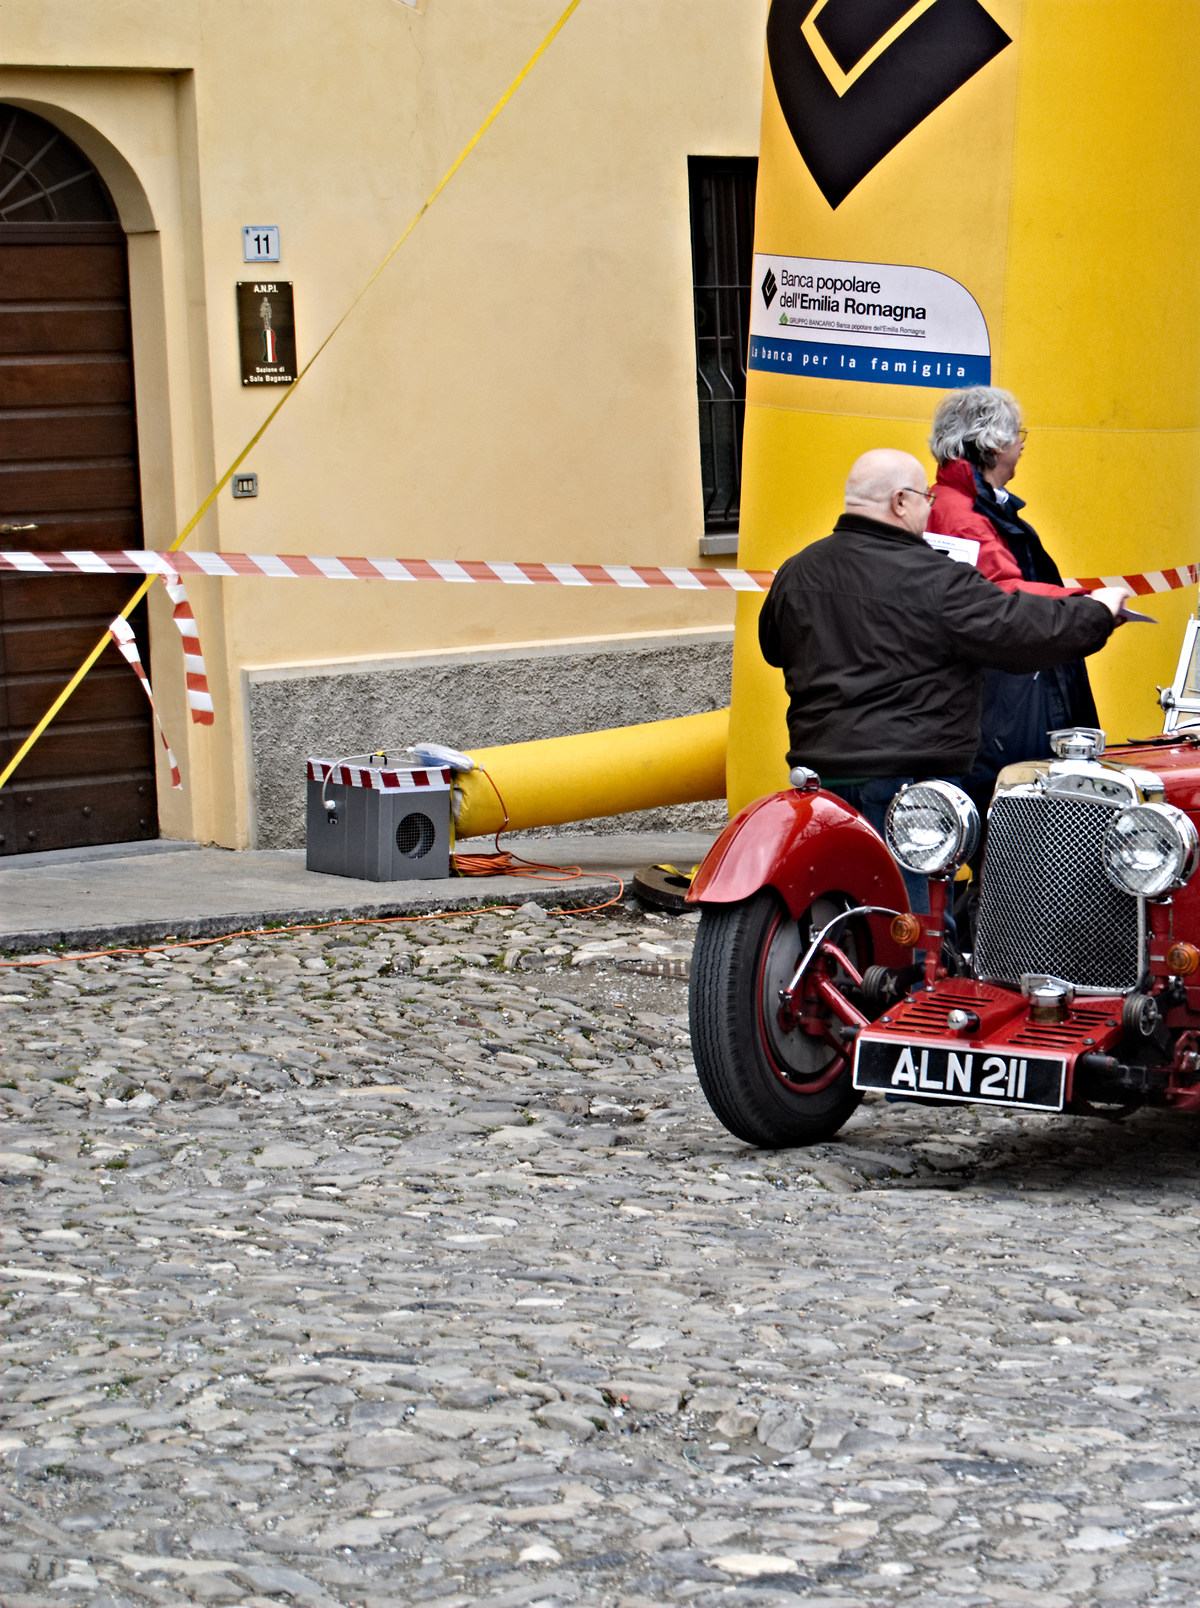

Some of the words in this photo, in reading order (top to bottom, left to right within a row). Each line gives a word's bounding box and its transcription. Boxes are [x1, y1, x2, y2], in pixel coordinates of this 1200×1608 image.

[253, 233, 270, 254] 11
[253, 284, 279, 293] A.N.P.I.
[781, 269, 813, 289] Banca
[816, 276, 881, 295] popolare
[779, 291, 840, 313] dell'Emilia
[844, 298, 927, 322] Romagna
[789, 316, 808, 325] GRUPPO
[808, 318, 836, 328] BANCARIO
[836, 321, 850, 329] Banca
[851, 323, 872, 332] popolare
[899, 328, 926, 336] Romagna
[255, 366, 278, 374] Sezione
[761, 345, 793, 363] banca
[802, 353, 828, 367] per
[840, 354, 857, 369] la
[871, 357, 966, 378] famiglia
[249, 375, 264, 383] Sala
[265, 375, 292, 384] Baganza
[891, 1047, 974, 1093] ALN
[980, 1056, 1027, 1098] 211
